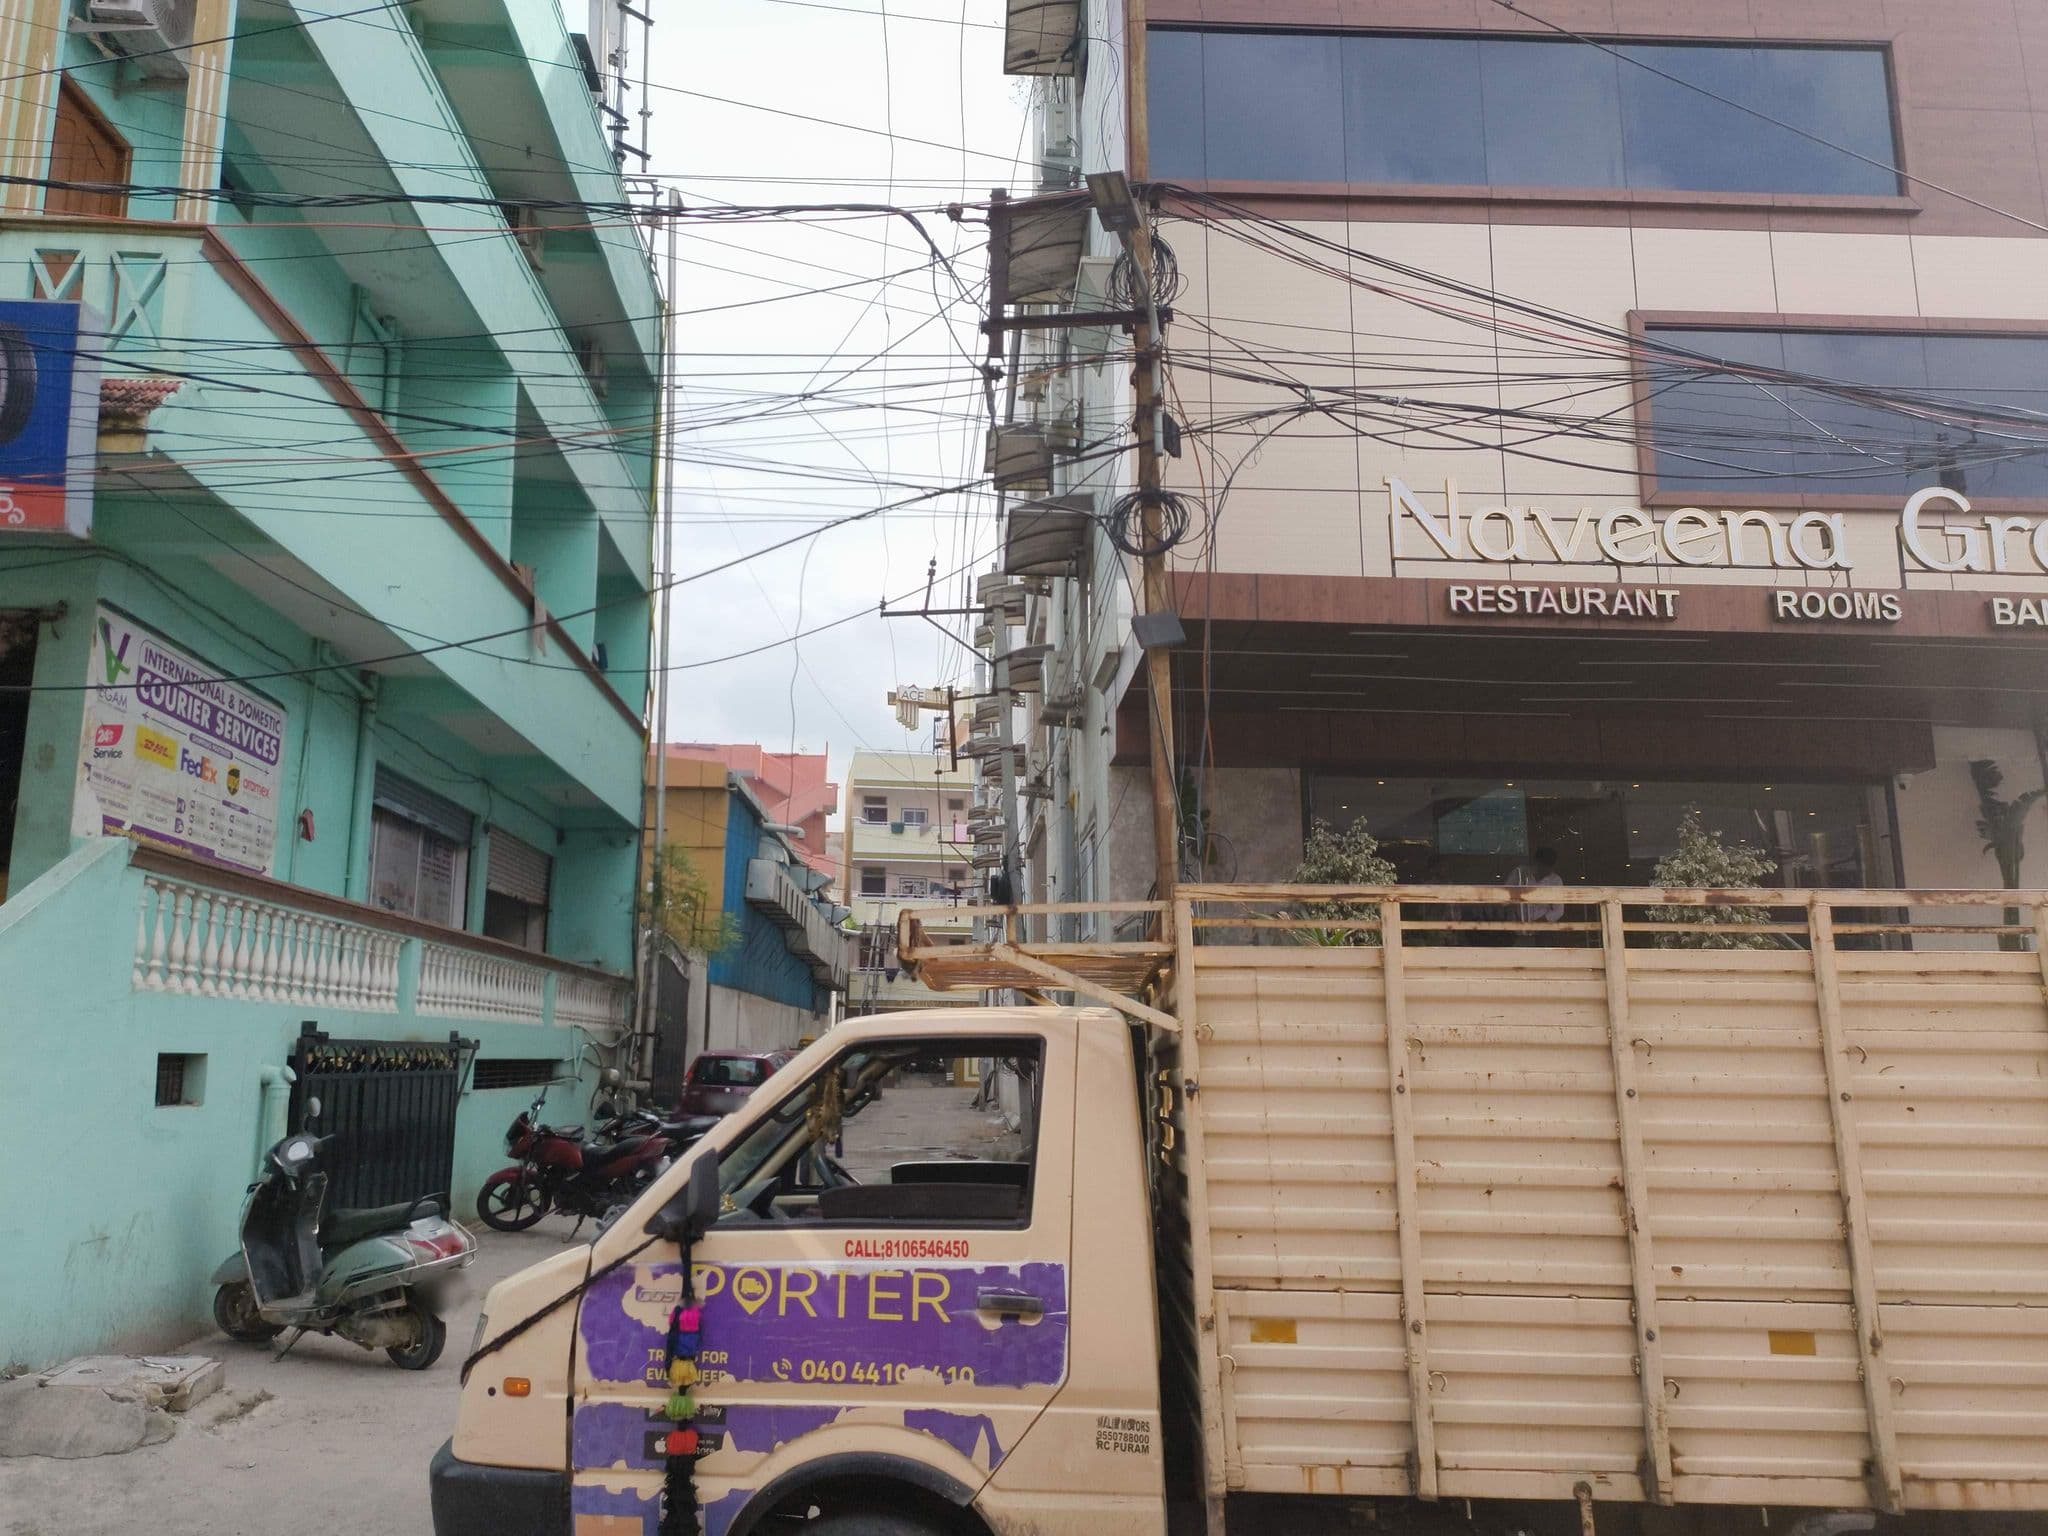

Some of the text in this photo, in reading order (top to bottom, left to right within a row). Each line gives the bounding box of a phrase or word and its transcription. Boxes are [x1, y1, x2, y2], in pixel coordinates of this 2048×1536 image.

[1384, 475, 2048, 572] Naveena Gr
[1449, 585, 1680, 617] RESTAURANT
[1775, 590, 1902, 621] ROOMS
[144, 646, 281, 735] INTERNATIONAL & DOMESTIC
[901, 691, 925, 701] ACE
[140, 672, 211, 729] COURIER
[215, 712, 277, 763] SERVICES
[93, 747, 123, 759] Service
[181, 747, 218, 785] FedEx
[701, 1351, 729, 1364] FOR
[801, 1359, 846, 1382] 040
[1096, 1440, 1150, 1454] RC PURAM
